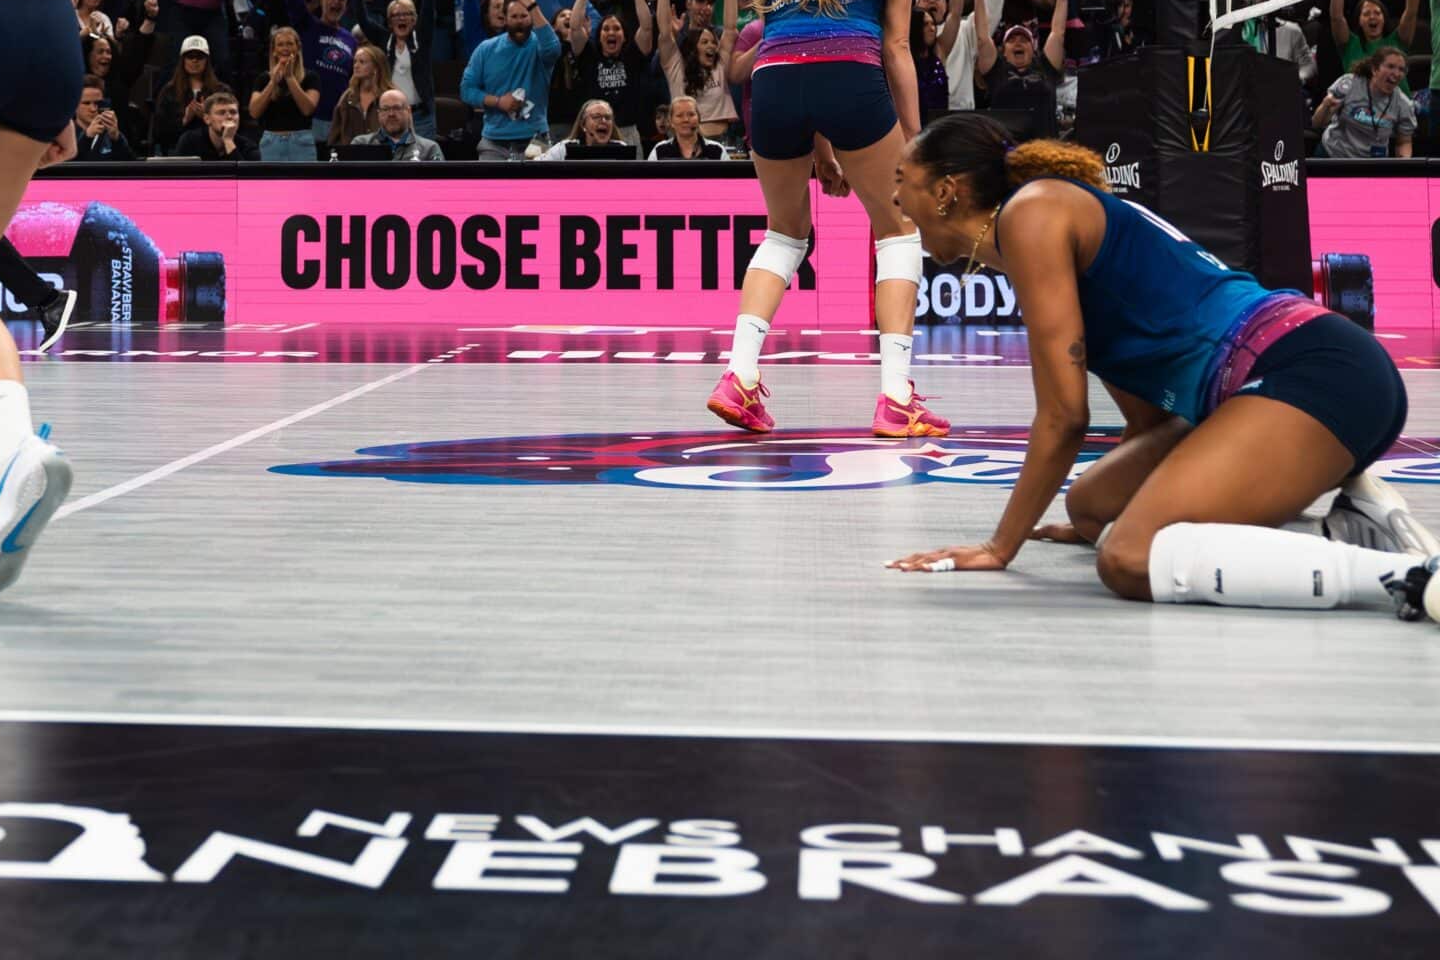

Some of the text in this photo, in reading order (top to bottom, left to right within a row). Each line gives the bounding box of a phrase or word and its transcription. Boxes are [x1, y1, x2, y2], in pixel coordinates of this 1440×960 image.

[1101, 161, 1141, 189] ALDING
[1261, 159, 1300, 188] SPALDING
[281, 214, 540, 291] CHOOSE
[297, 809, 1440, 864] NEWS CHANN
